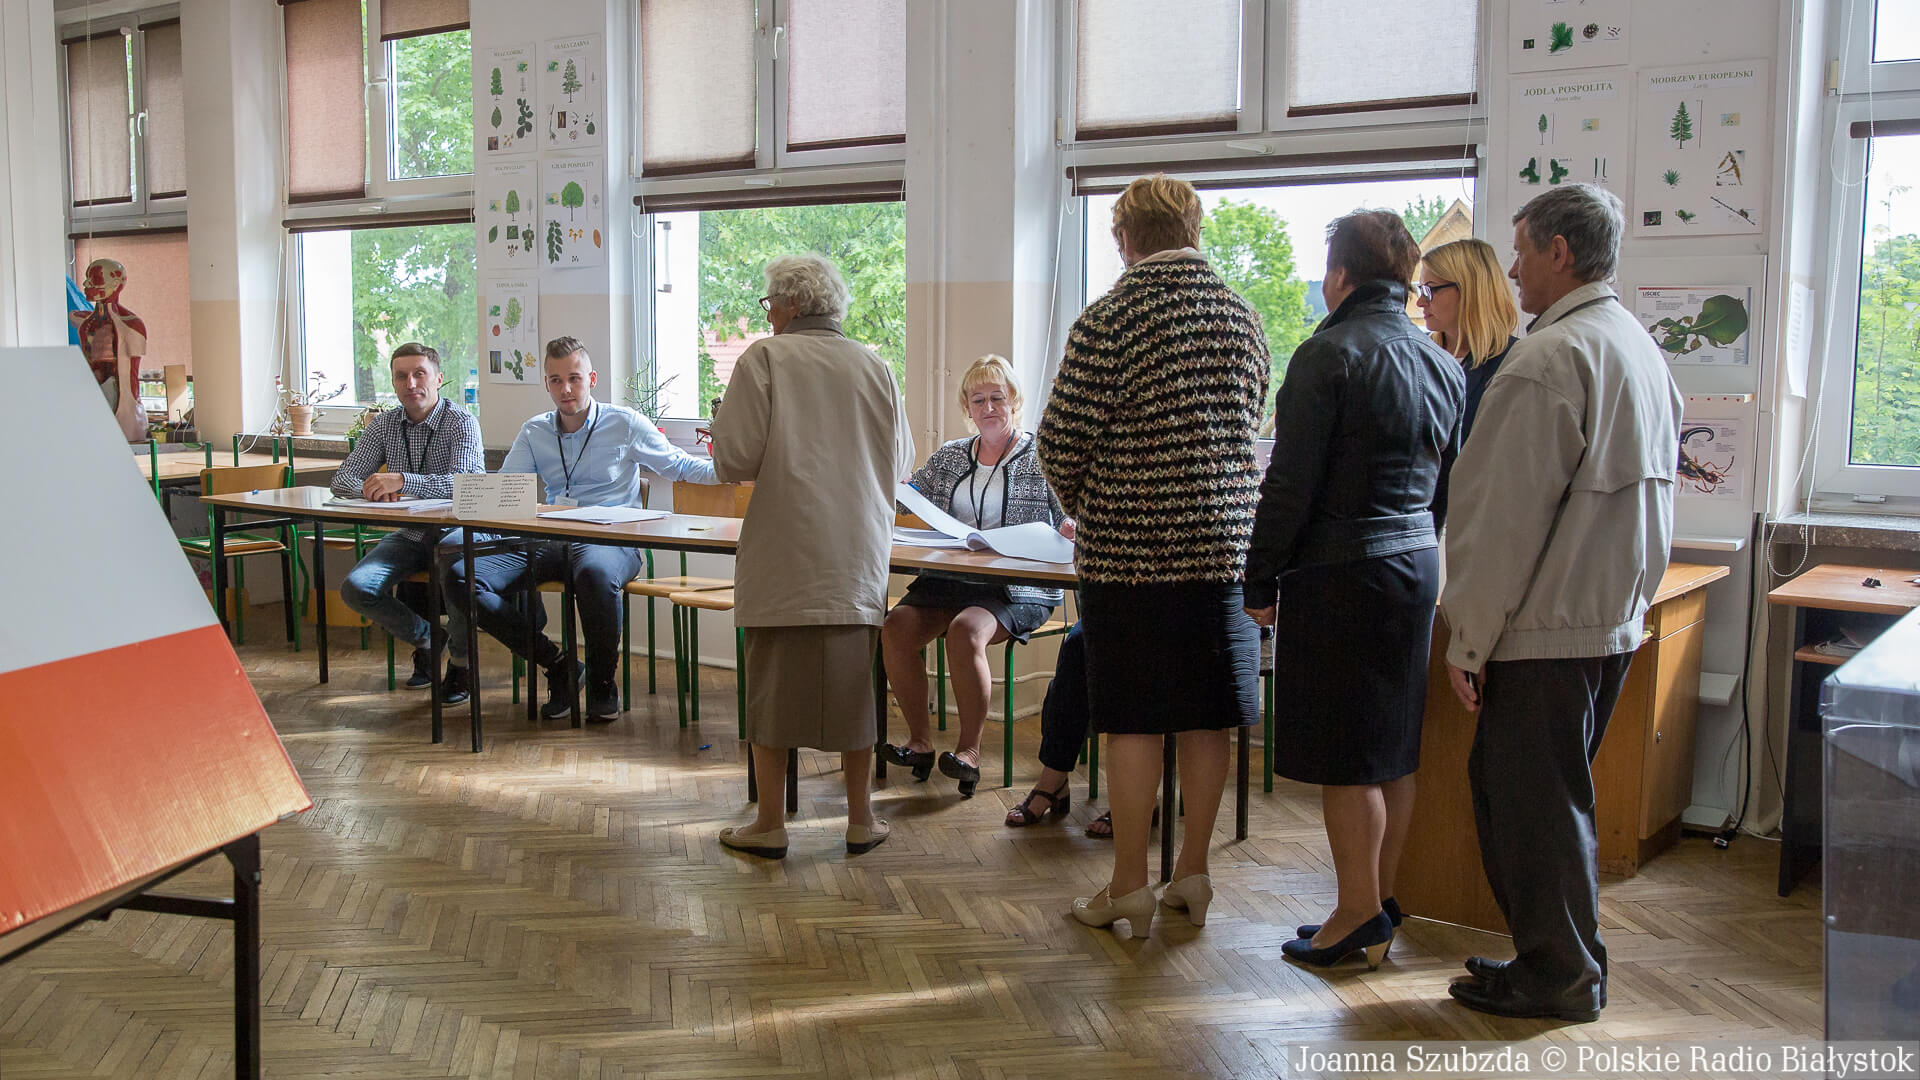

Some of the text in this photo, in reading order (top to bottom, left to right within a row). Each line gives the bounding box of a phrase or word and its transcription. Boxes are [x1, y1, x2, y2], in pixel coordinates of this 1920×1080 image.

[1650, 70, 1754, 85] MODRZEW EUROPEJSKI
[1558, 82, 1614, 95] POSPOLITA
